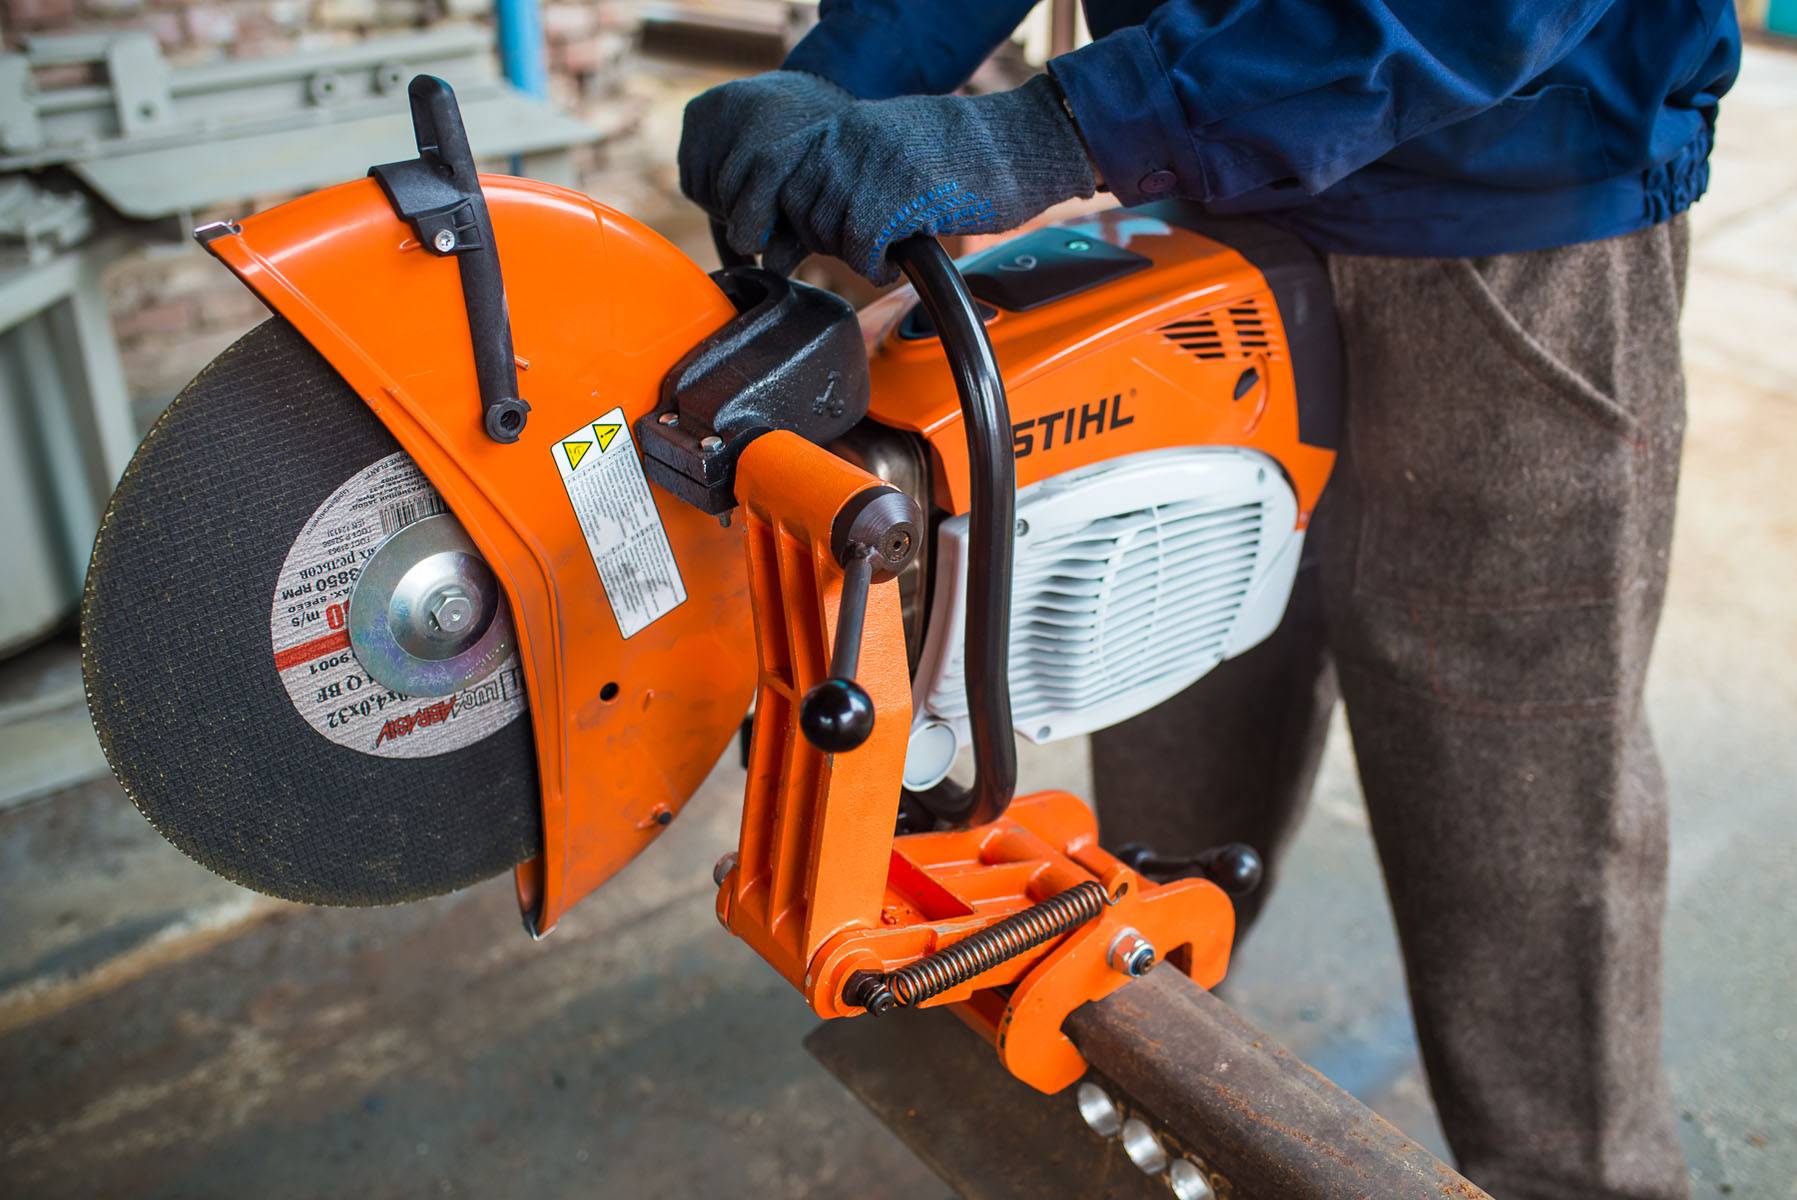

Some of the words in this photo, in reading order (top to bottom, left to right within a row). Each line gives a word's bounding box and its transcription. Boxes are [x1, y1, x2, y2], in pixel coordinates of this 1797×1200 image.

[1014, 394, 1134, 459] STIHL
[299, 551, 355, 579] рельсов
[315, 567, 361, 592] 3850
[282, 583, 312, 600] RPM
[330, 587, 352, 600] AX.
[287, 595, 327, 613] SPEED
[291, 610, 320, 627] m/s
[309, 653, 349, 675] 9001
[315, 683, 342, 704] BF
